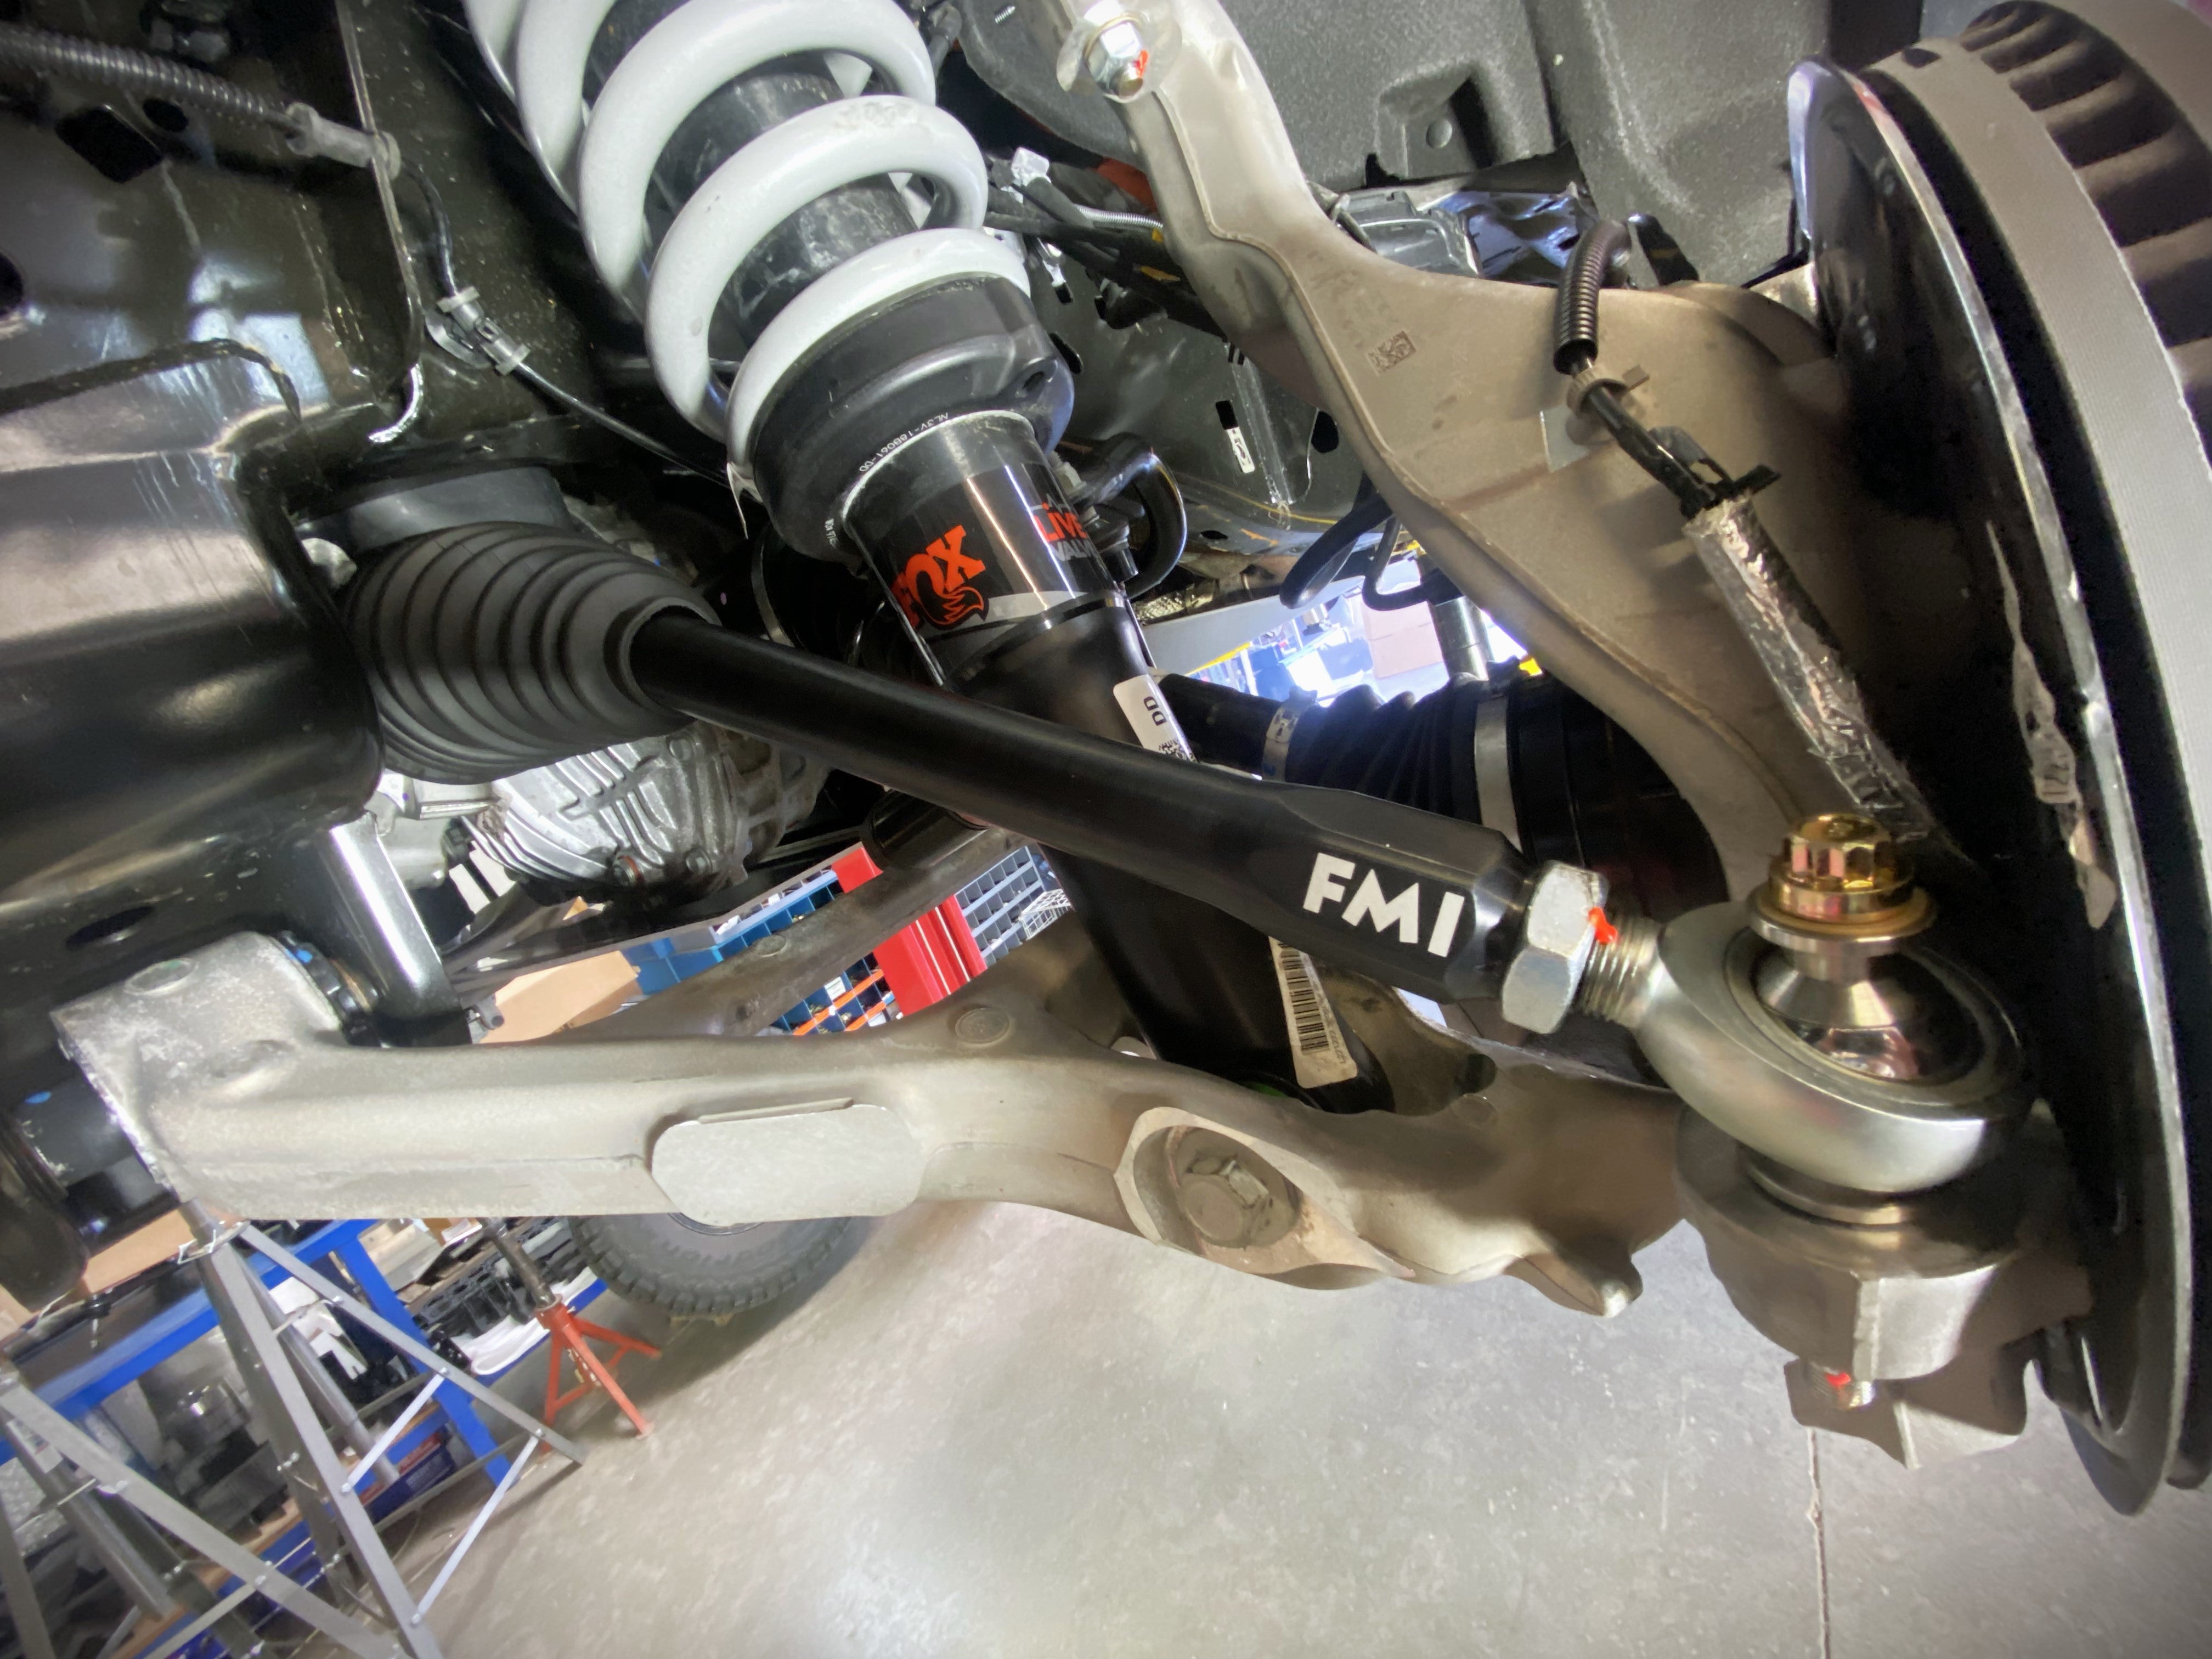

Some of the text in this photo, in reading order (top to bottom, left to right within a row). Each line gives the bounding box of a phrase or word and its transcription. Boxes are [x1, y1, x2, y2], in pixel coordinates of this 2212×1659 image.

[1048, 539, 1099, 561] VALV
[1144, 696, 1166, 726] DD
[1302, 852, 1465, 958] FMI
